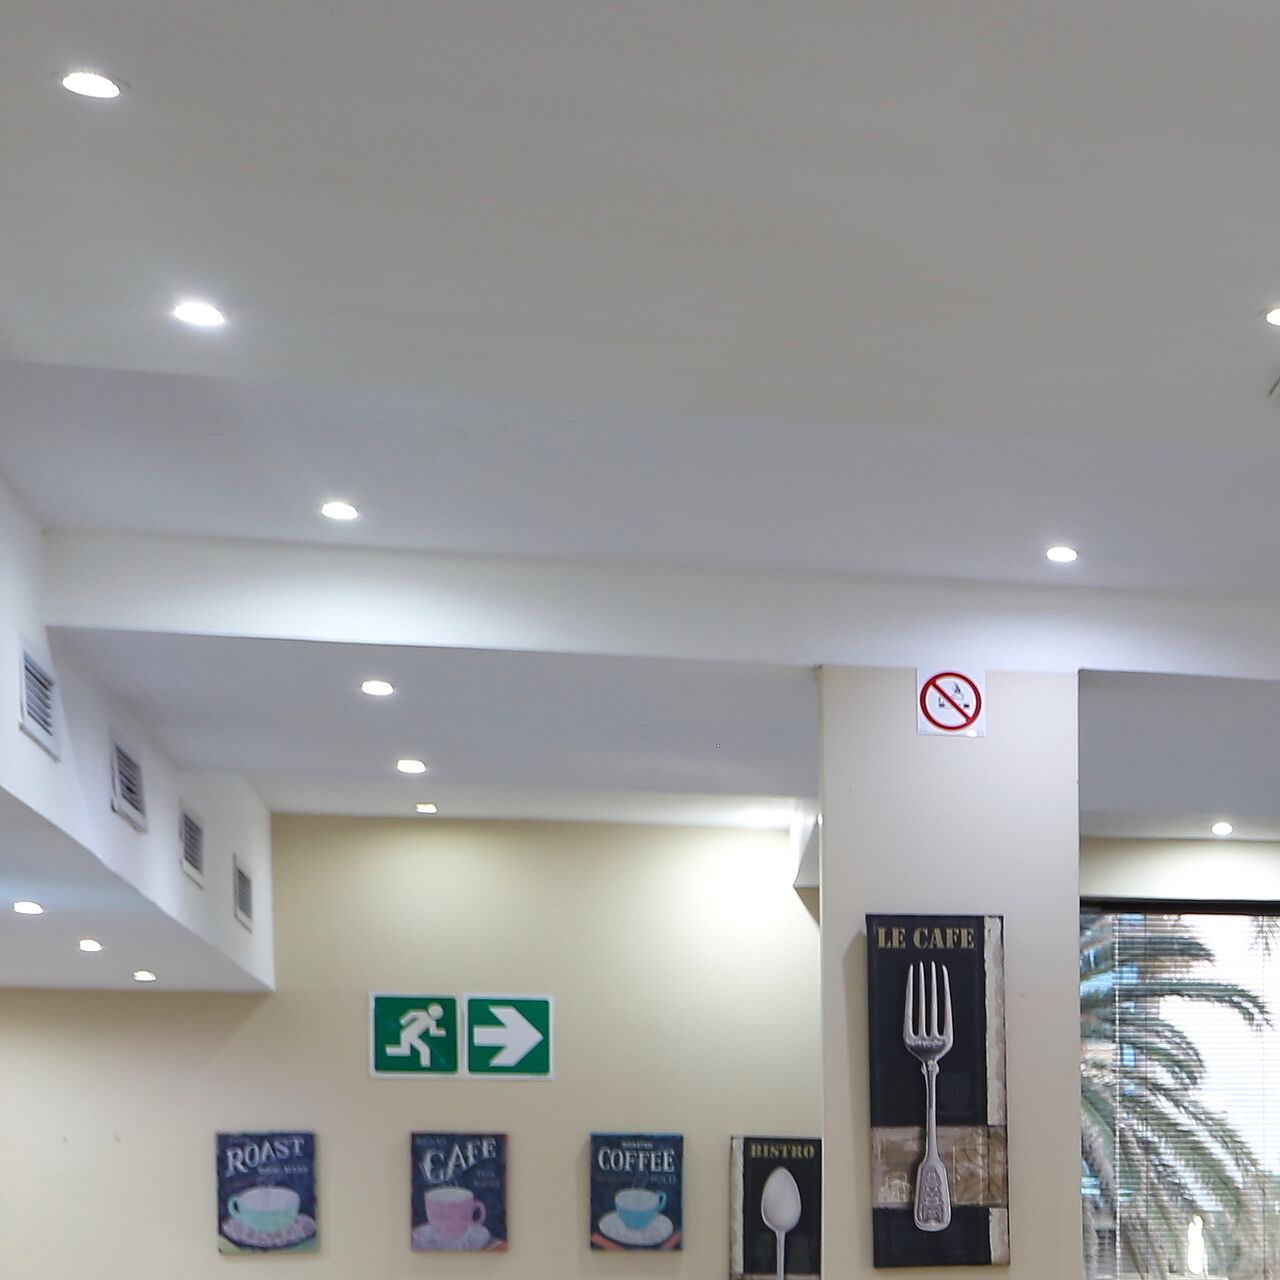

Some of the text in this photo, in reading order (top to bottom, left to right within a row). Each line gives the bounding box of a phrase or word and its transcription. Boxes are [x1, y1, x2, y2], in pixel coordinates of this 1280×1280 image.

[877, 927, 975, 949] LE CAFE
[225, 1138, 304, 1178] ROAST
[421, 1137, 497, 1184] CAFE
[598, 1147, 675, 1172] COFFEE
[751, 1144, 815, 1158] BISTRO
